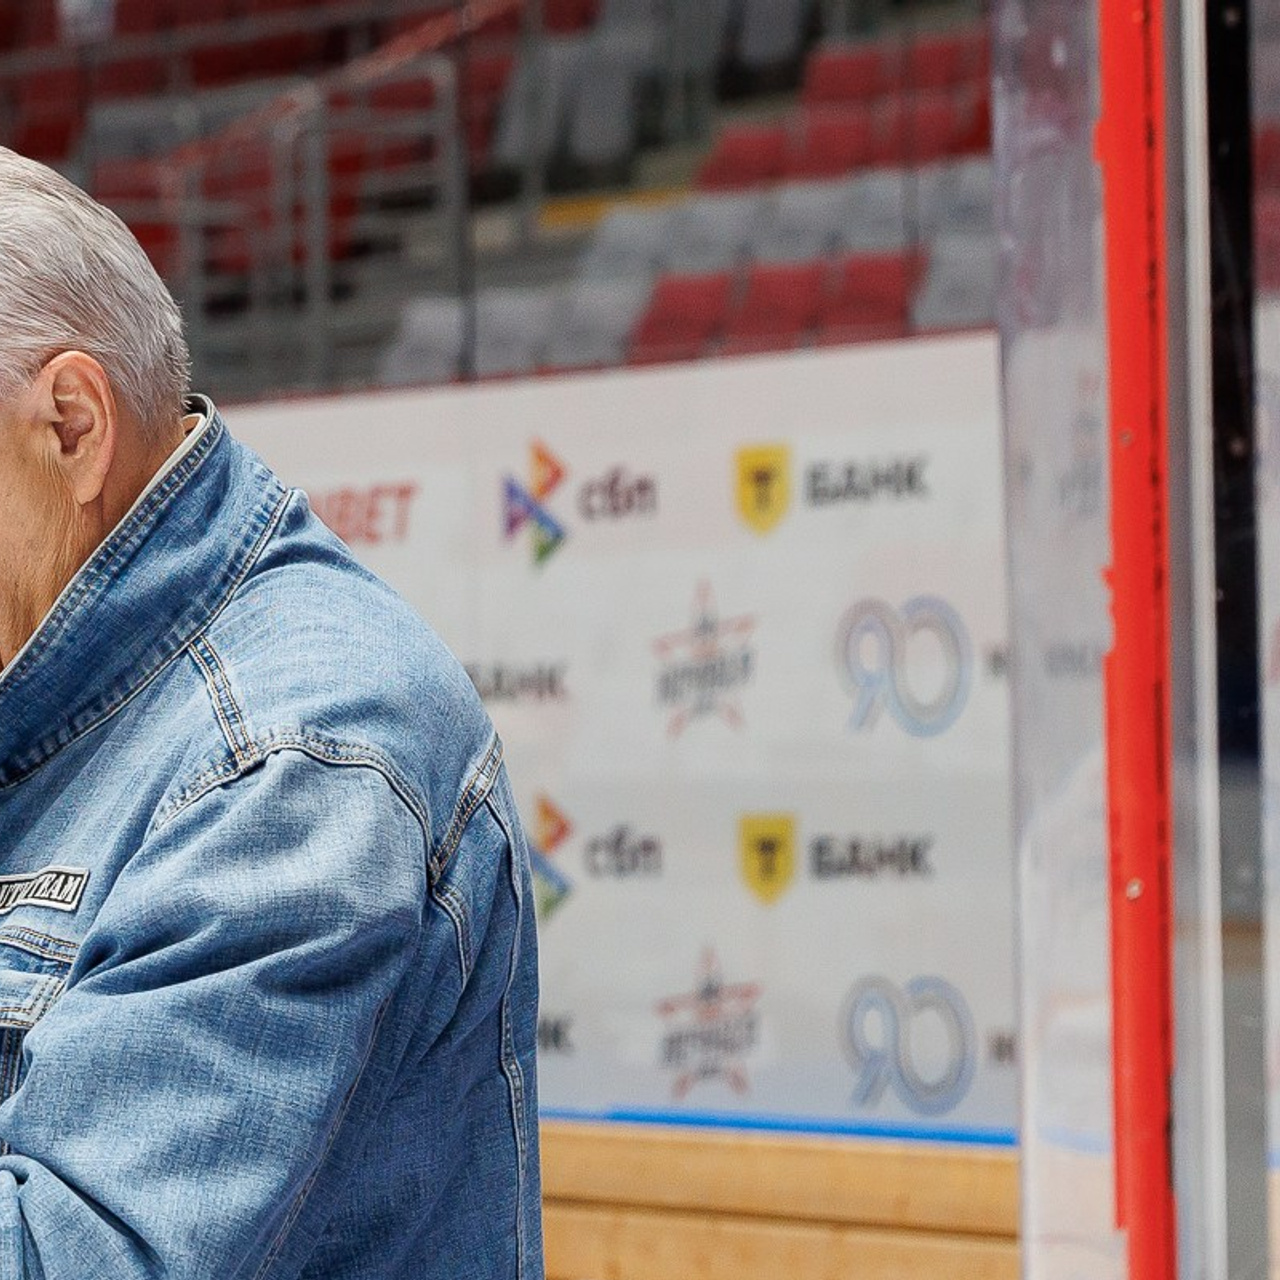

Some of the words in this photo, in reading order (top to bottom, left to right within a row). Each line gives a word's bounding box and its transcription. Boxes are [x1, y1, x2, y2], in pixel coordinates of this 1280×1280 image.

[805, 454, 928, 508] БАНК
[311, 477, 420, 545] BET
[810, 832, 936, 882] БАНК
